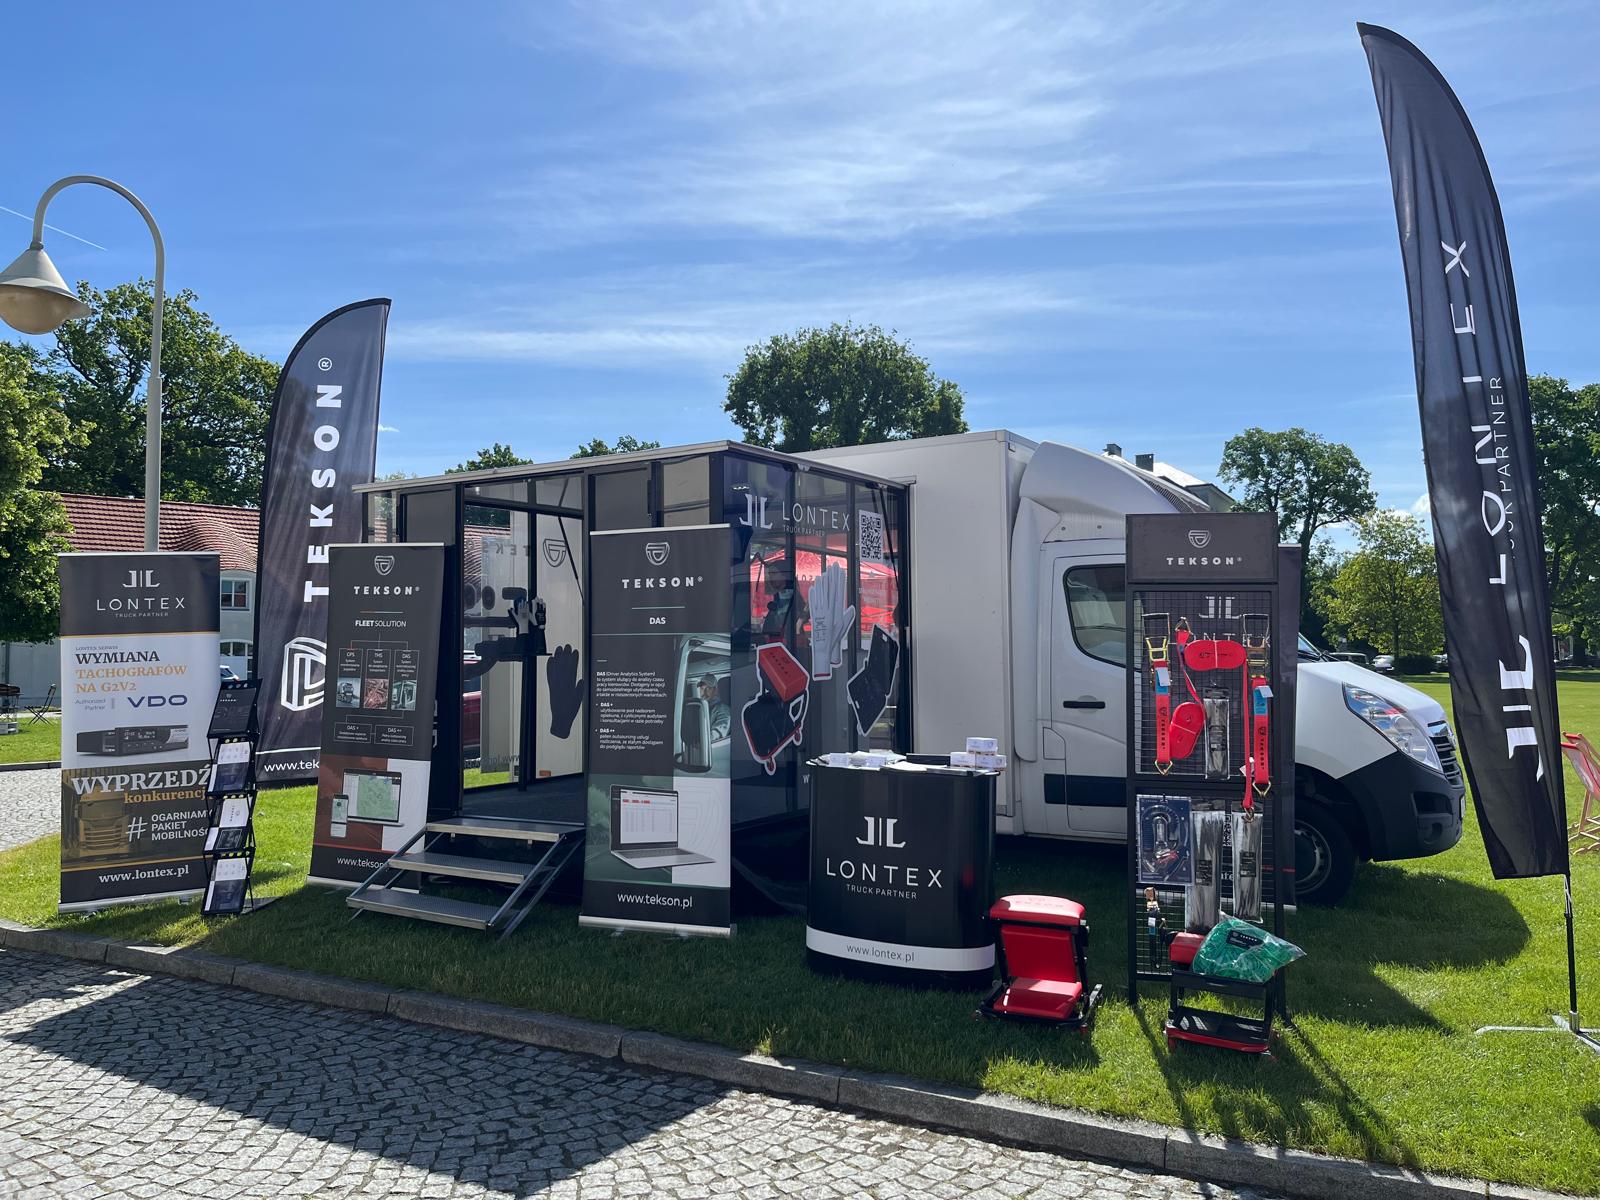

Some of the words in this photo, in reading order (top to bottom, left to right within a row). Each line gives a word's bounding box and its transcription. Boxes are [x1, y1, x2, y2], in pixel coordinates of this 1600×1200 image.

[1490, 376, 1512, 492] PARTNER
[783, 501, 850, 531] LONTEX
[96, 597, 185, 611] LONTEX
[649, 617, 666, 625] DAS
[75, 651, 160, 664] WYMIANA
[75, 664, 187, 680] TACHOGRAFÓW
[75, 682, 96, 694] NA
[101, 681, 136, 692] G2V2
[127, 694, 188, 708] VDO
[264, 759, 320, 772] www.tek
[70, 763, 211, 795] WYPRZEDŹ
[124, 787, 211, 804] konkurencj
[151, 820, 187, 832] PAKIET
[98, 864, 190, 883] www.lontex.pl
[826, 857, 942, 889] LONTEX
[846, 884, 874, 894] TRUCK
[875, 888, 917, 900] PARTNER
[617, 894, 693, 910] www.tekson.pl
[846, 945, 915, 962] www.lontex.pl
